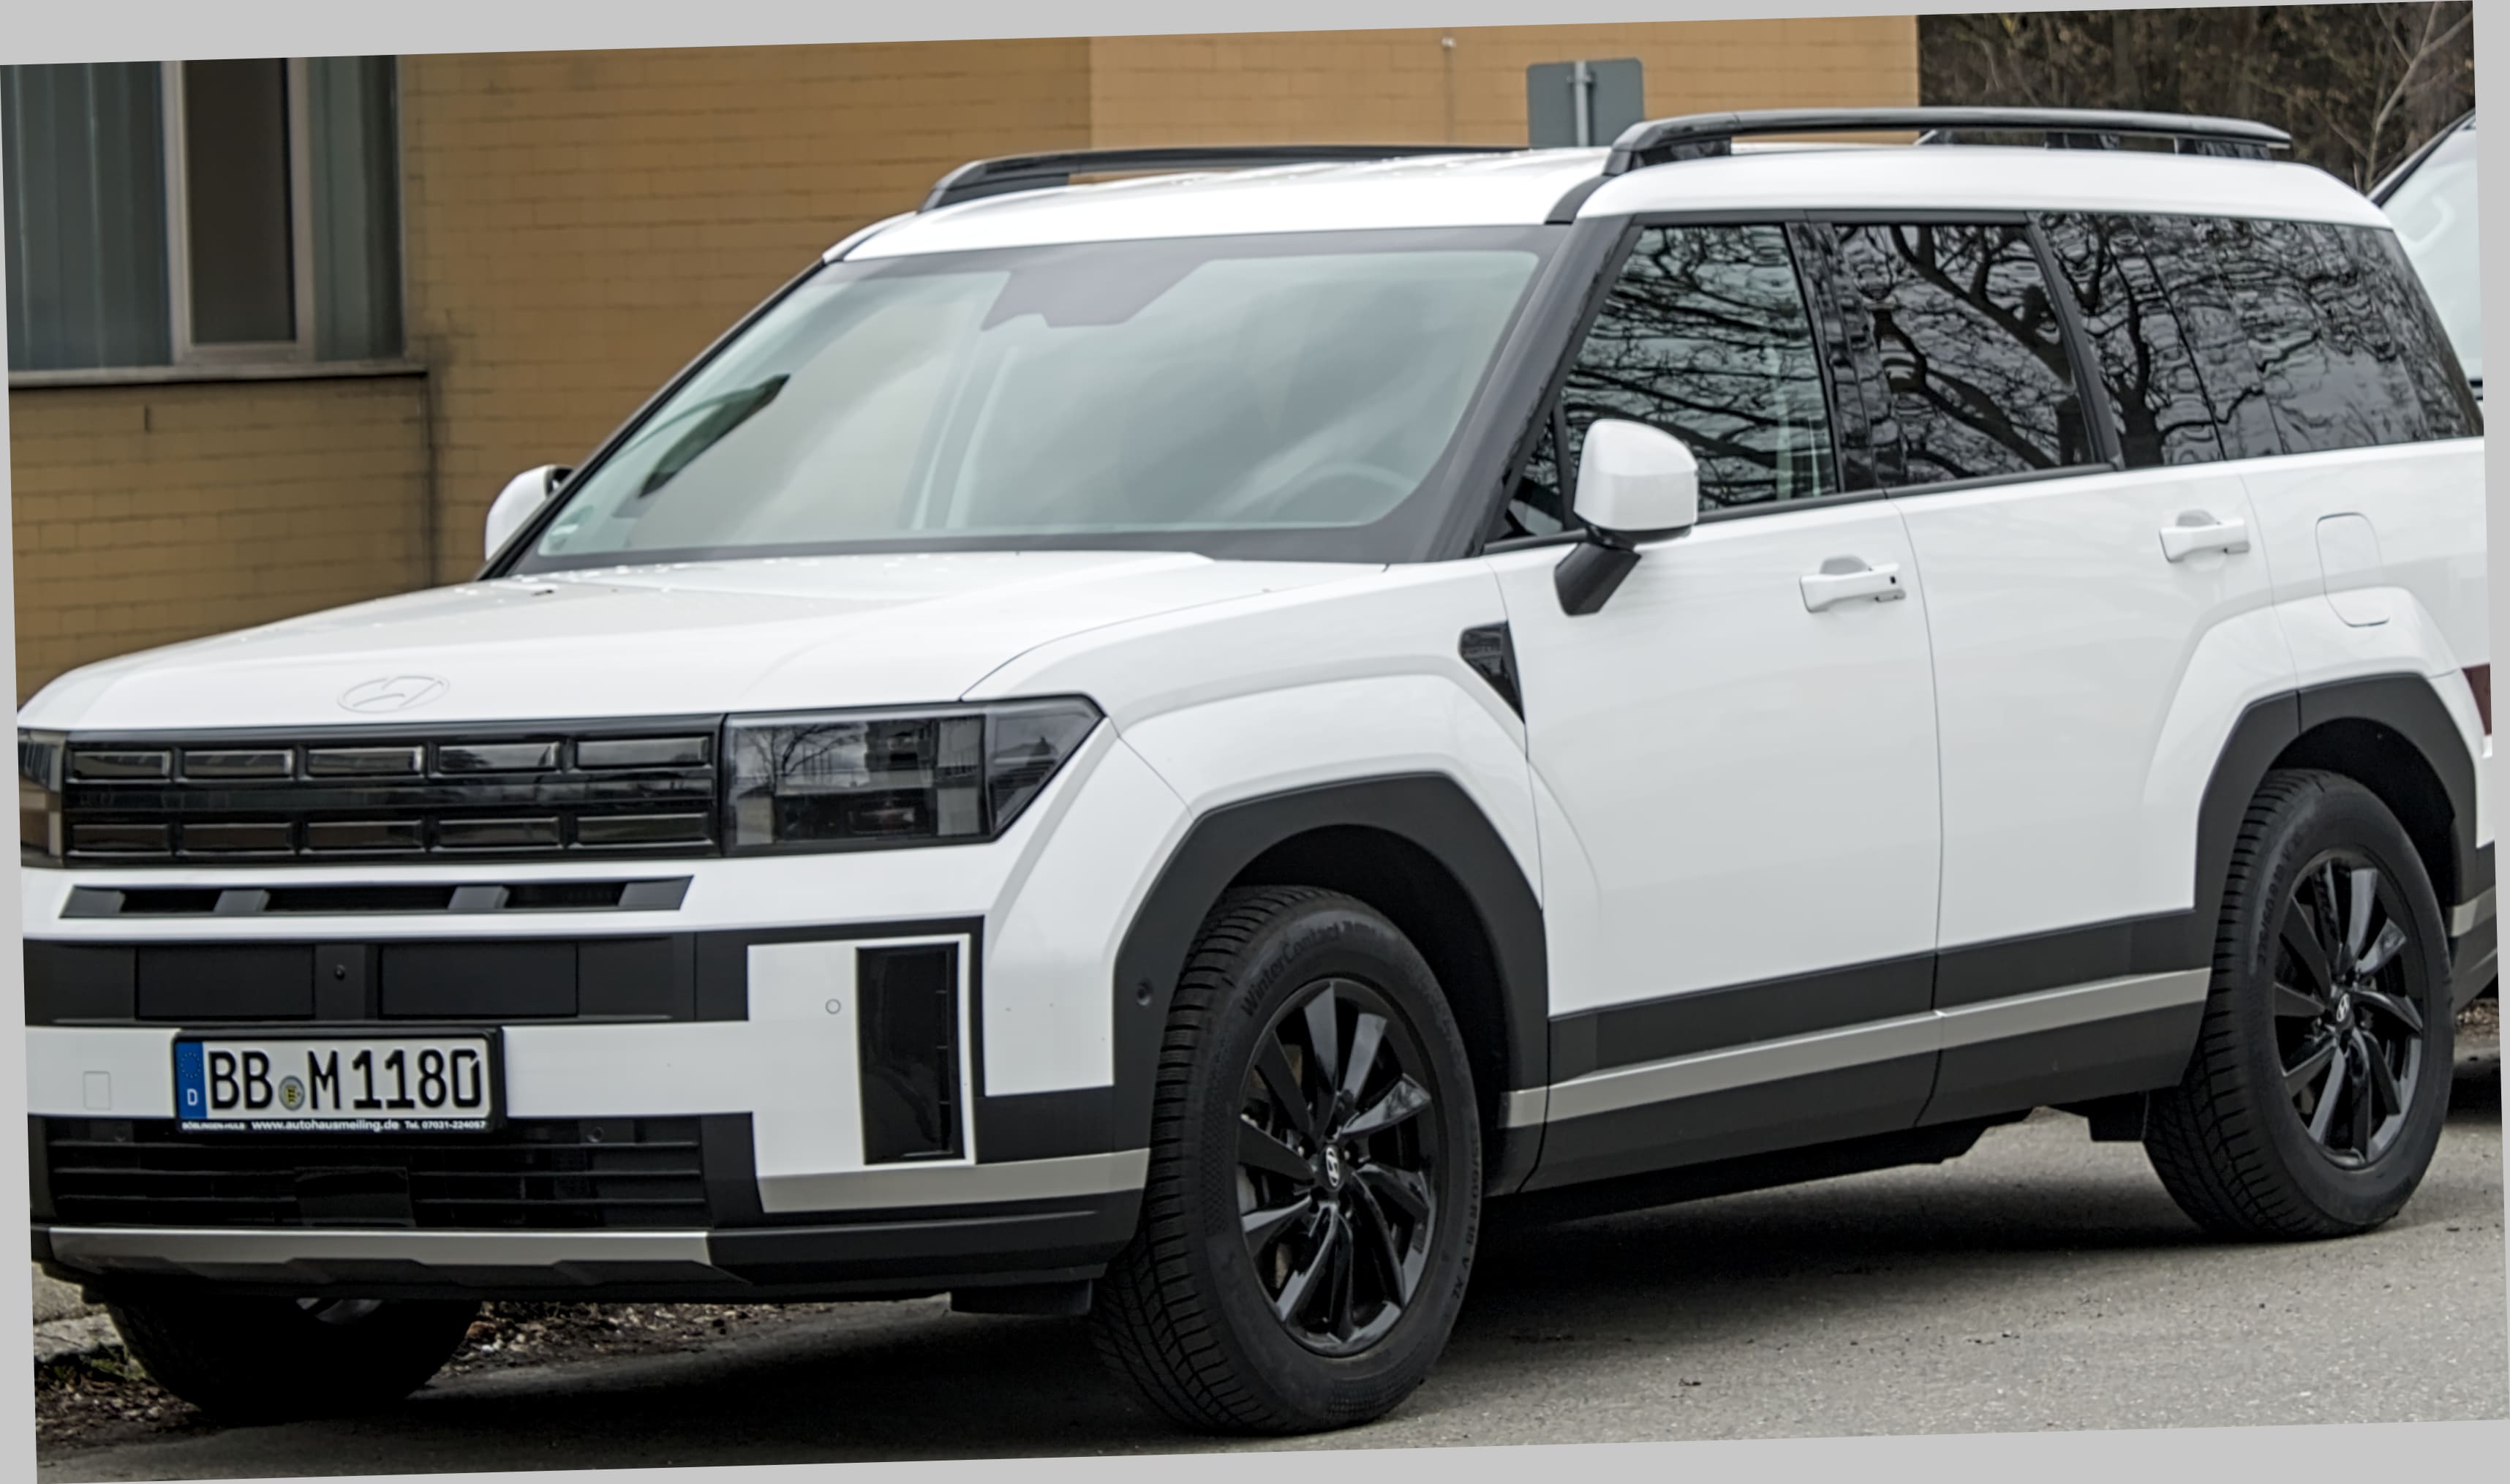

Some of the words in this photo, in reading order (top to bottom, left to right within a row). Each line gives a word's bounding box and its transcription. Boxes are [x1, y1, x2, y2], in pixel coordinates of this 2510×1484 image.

[208, 1050, 274, 1110] BB
[307, 1050, 342, 1110] M
[352, 1049, 483, 1110] 1180
[186, 1088, 198, 1107] D
[252, 1118, 399, 1132] www.autohausmeiling.de
